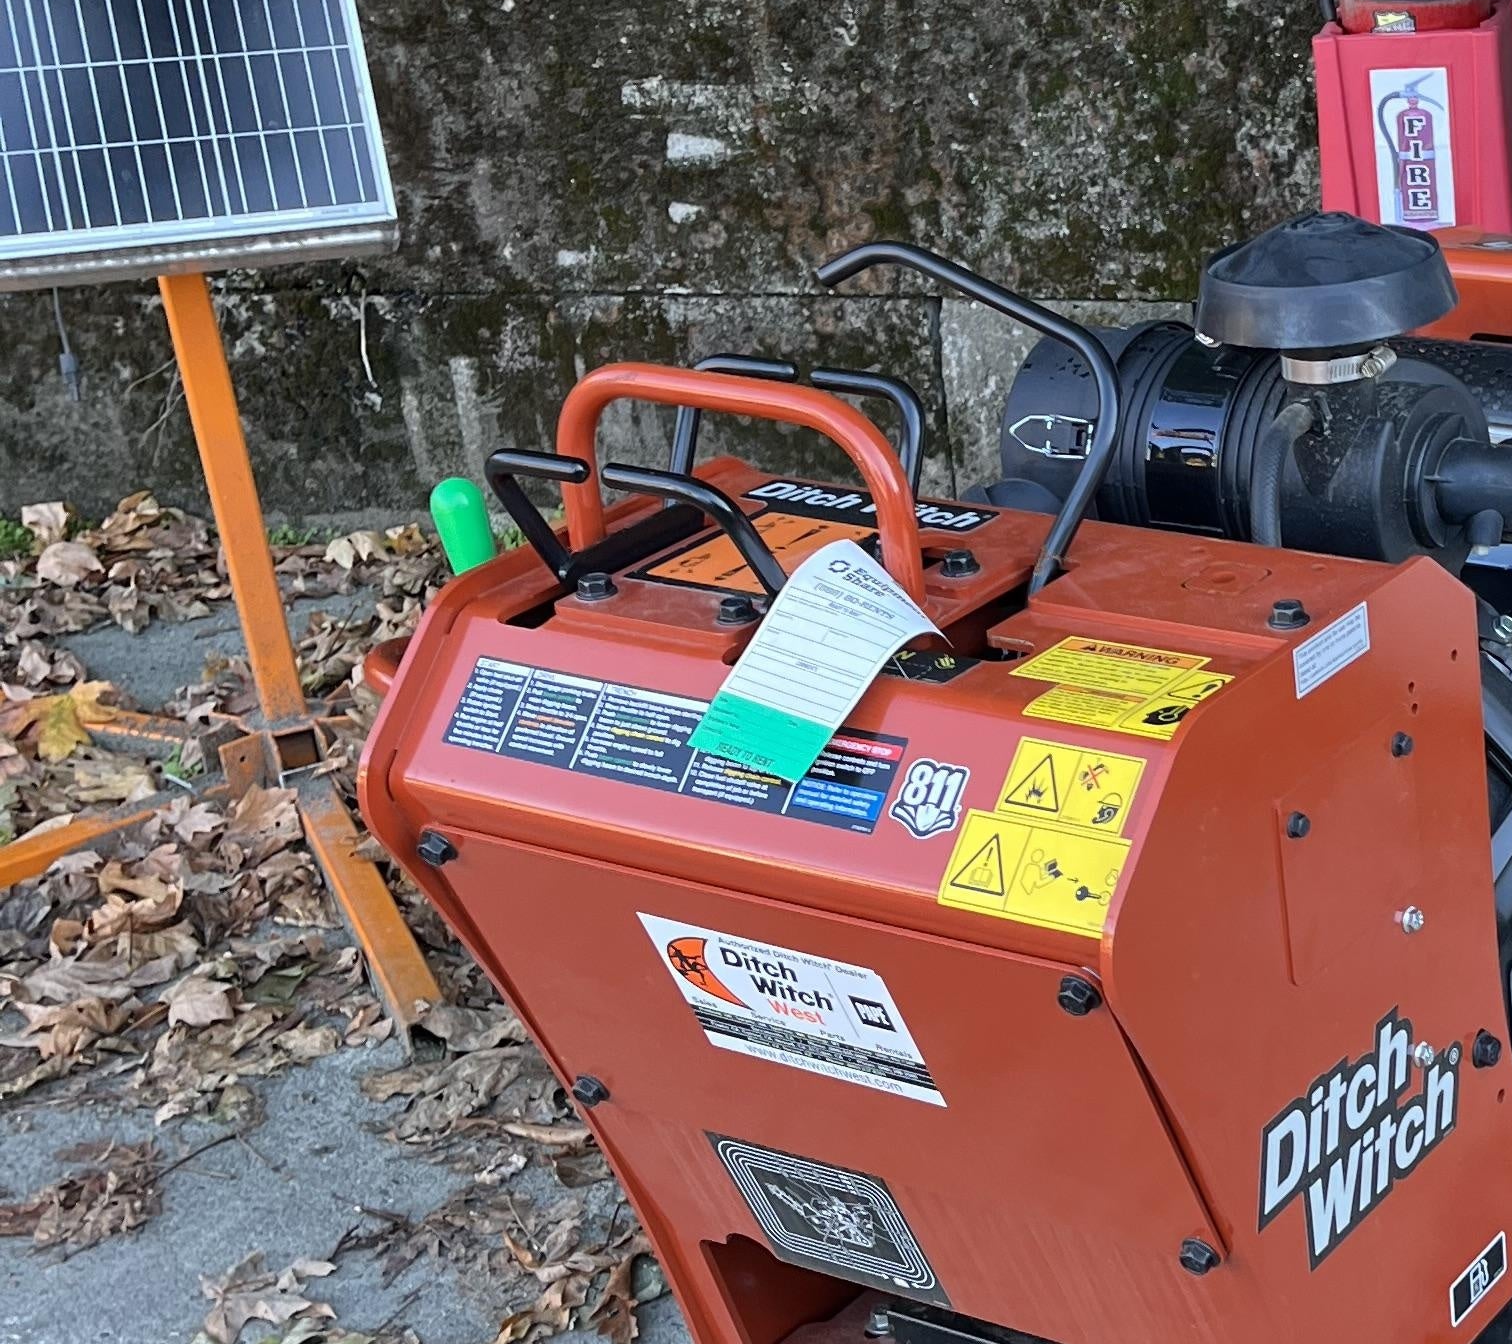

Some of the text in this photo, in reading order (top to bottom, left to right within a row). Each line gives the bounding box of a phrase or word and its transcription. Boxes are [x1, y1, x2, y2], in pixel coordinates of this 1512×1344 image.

[1406, 117, 1430, 209] FIRE
[749, 482, 863, 509] Ditch
[842, 573, 885, 598] Share
[1098, 645, 1180, 665] WARNING
[908, 763, 963, 810] 811
[720, 947, 798, 983] Ditch
[750, 974, 832, 1011] Witch
[767, 999, 827, 1026] West
[744, 1043, 904, 1094] www.ditchwitchwest.com
[1264, 1022, 1408, 1216] Ditch
[1308, 1064, 1455, 1256] Witch
